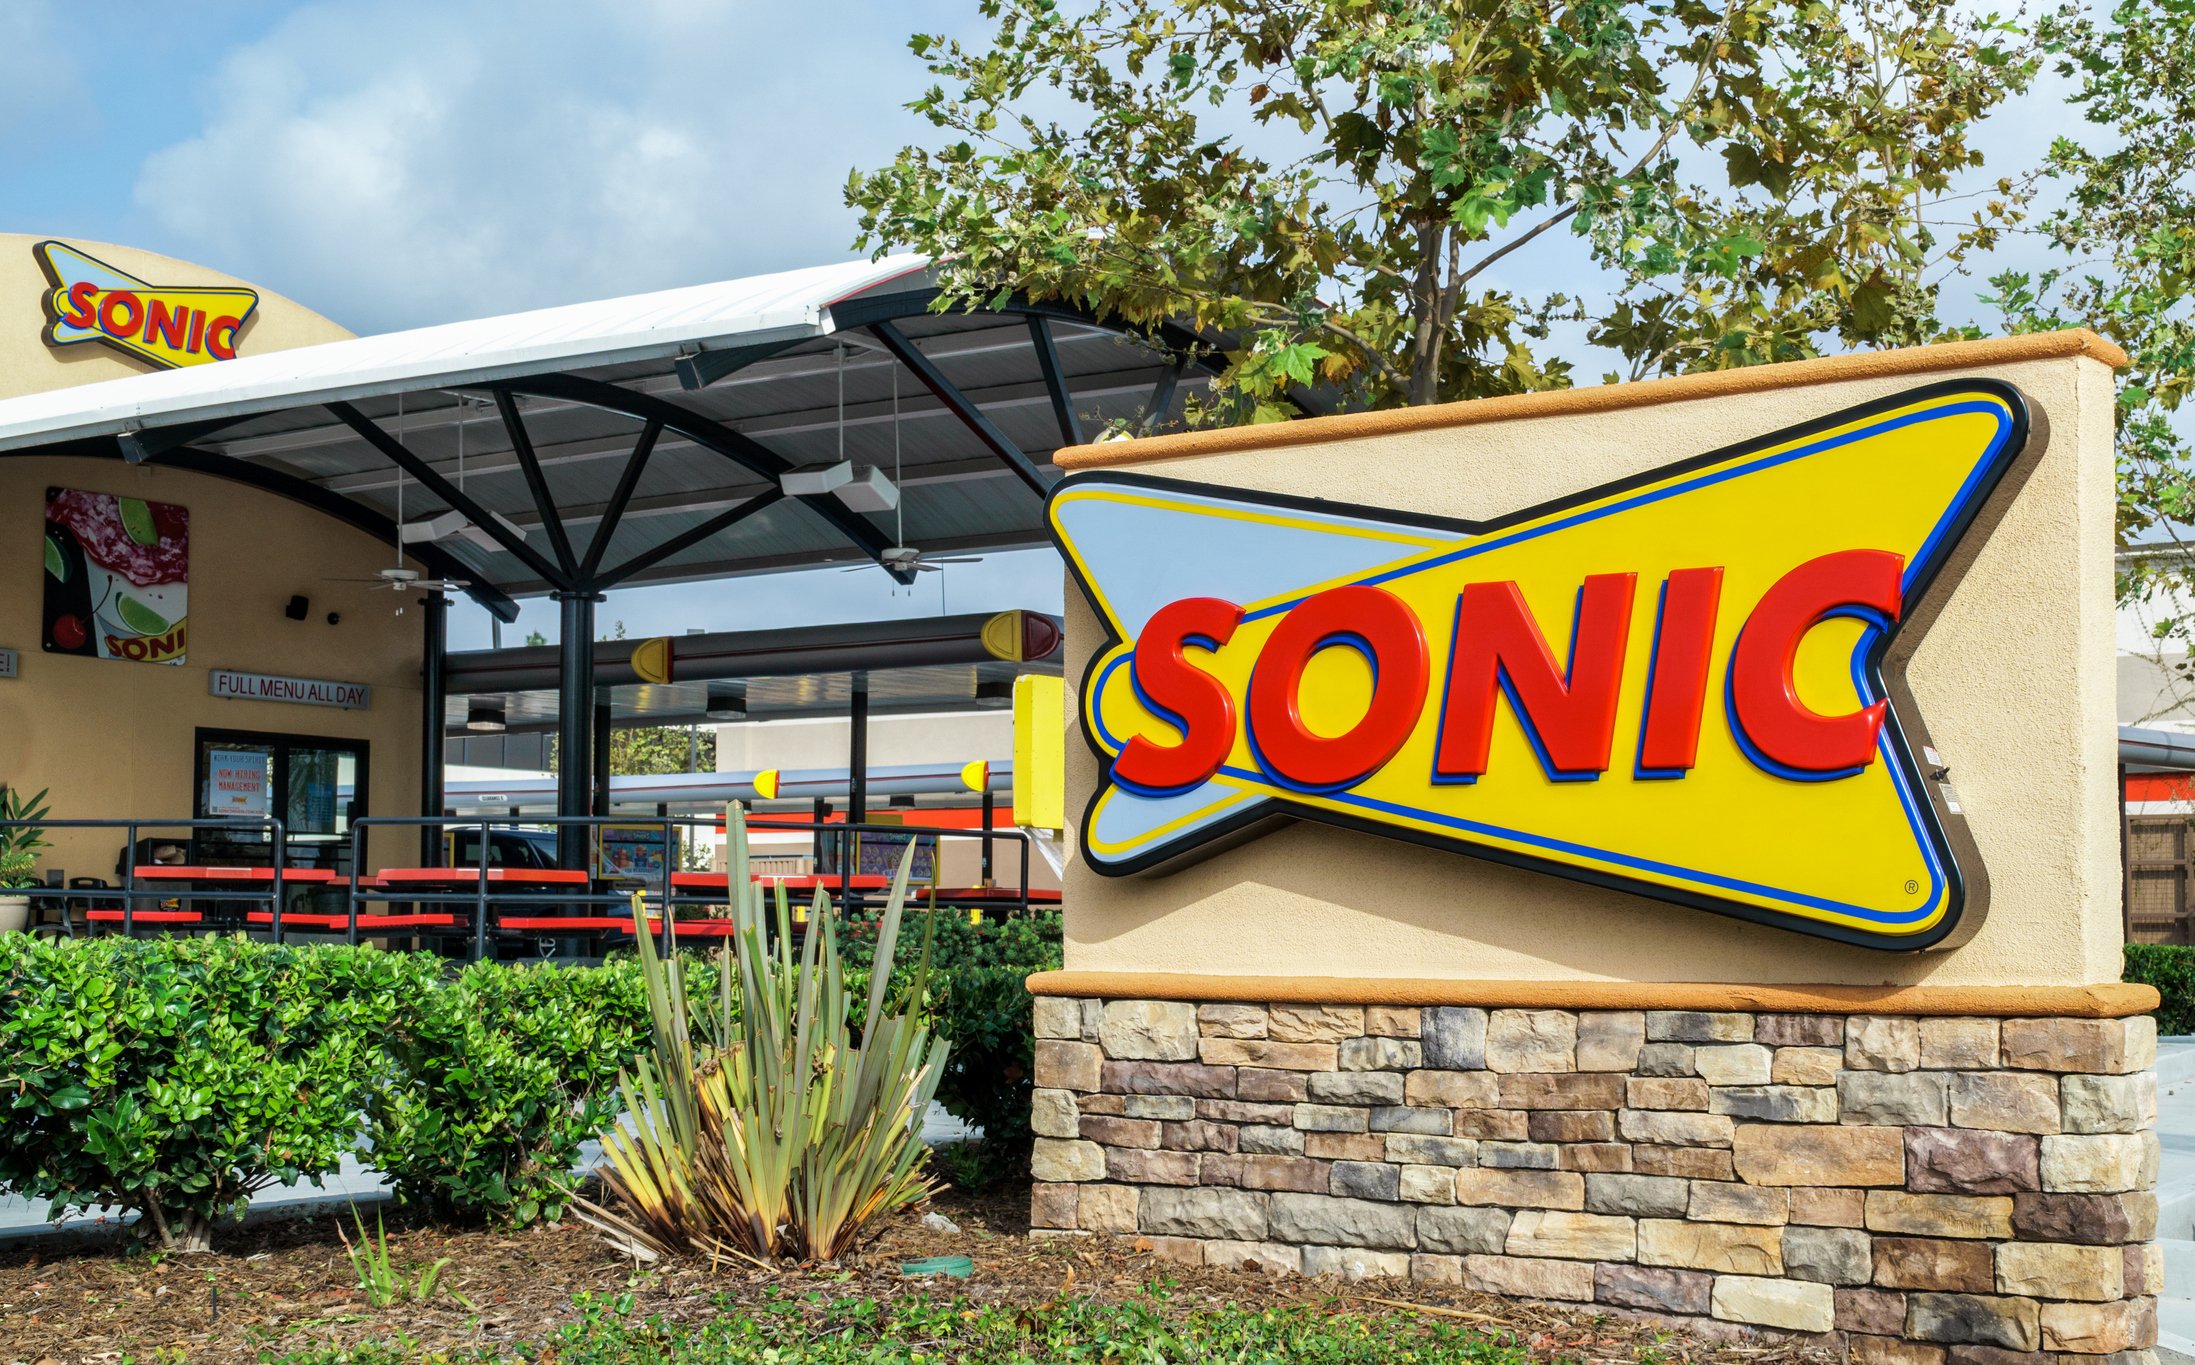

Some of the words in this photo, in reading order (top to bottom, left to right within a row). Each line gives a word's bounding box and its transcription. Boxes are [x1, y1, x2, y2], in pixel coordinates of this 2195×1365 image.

[60, 281, 240, 362] SONIC
[106, 627, 185, 660] SONI
[1110, 547, 1907, 798] SONIC
[218, 674, 256, 695] FULL
[259, 678, 305, 700] MENU
[307, 684, 333, 703] ALL
[336, 686, 365, 706] DAY
[218, 768, 232, 779] NOW
[234, 769, 260, 780] HIRING
[218, 781, 260, 792] MANAGEMENT
